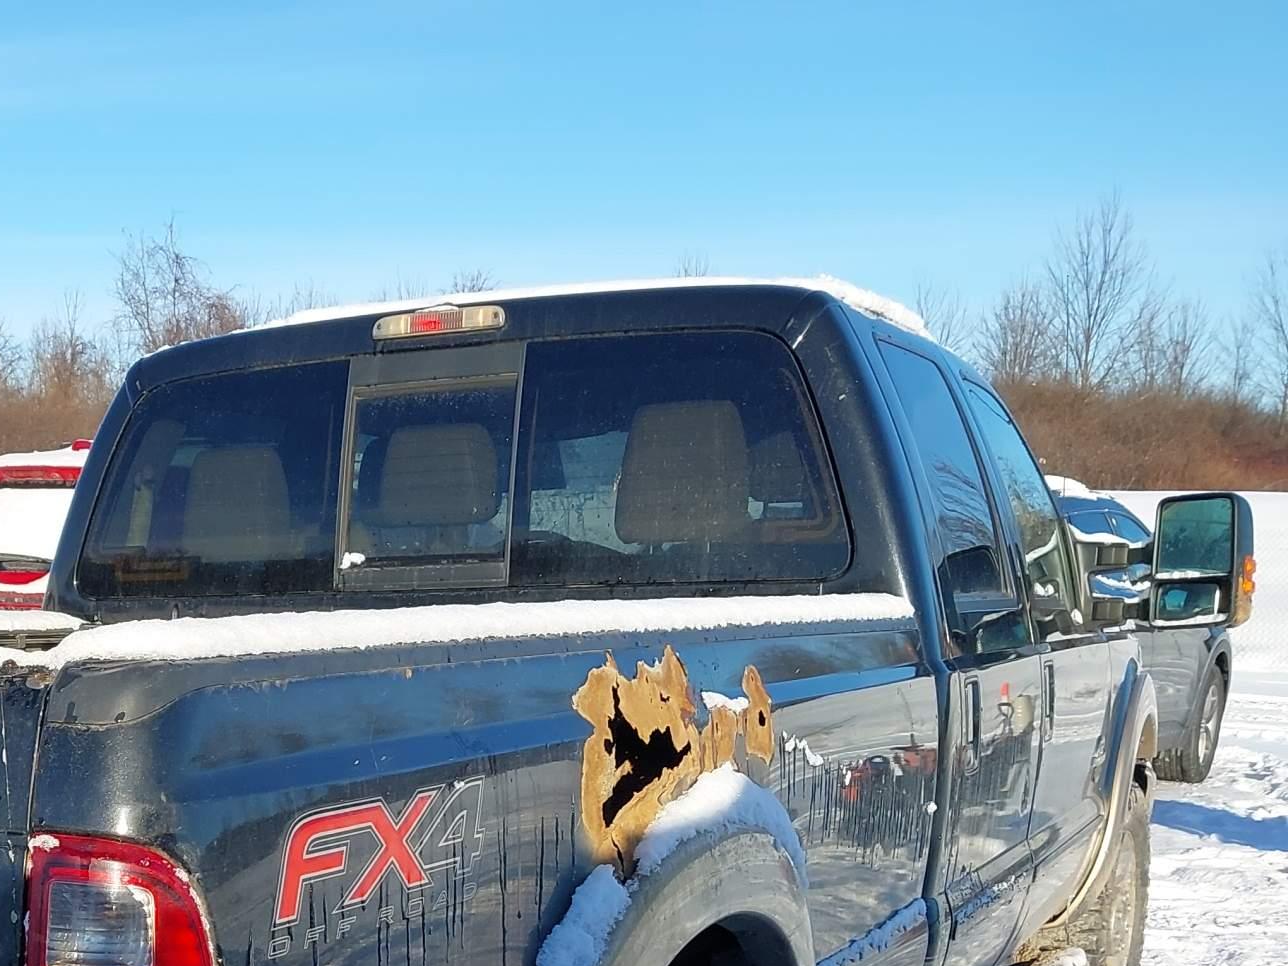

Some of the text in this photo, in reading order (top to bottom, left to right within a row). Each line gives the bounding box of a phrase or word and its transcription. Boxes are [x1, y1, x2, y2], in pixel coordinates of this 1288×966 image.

[272, 775, 486, 931] FX4
[268, 882, 478, 960] OFF ROAD
